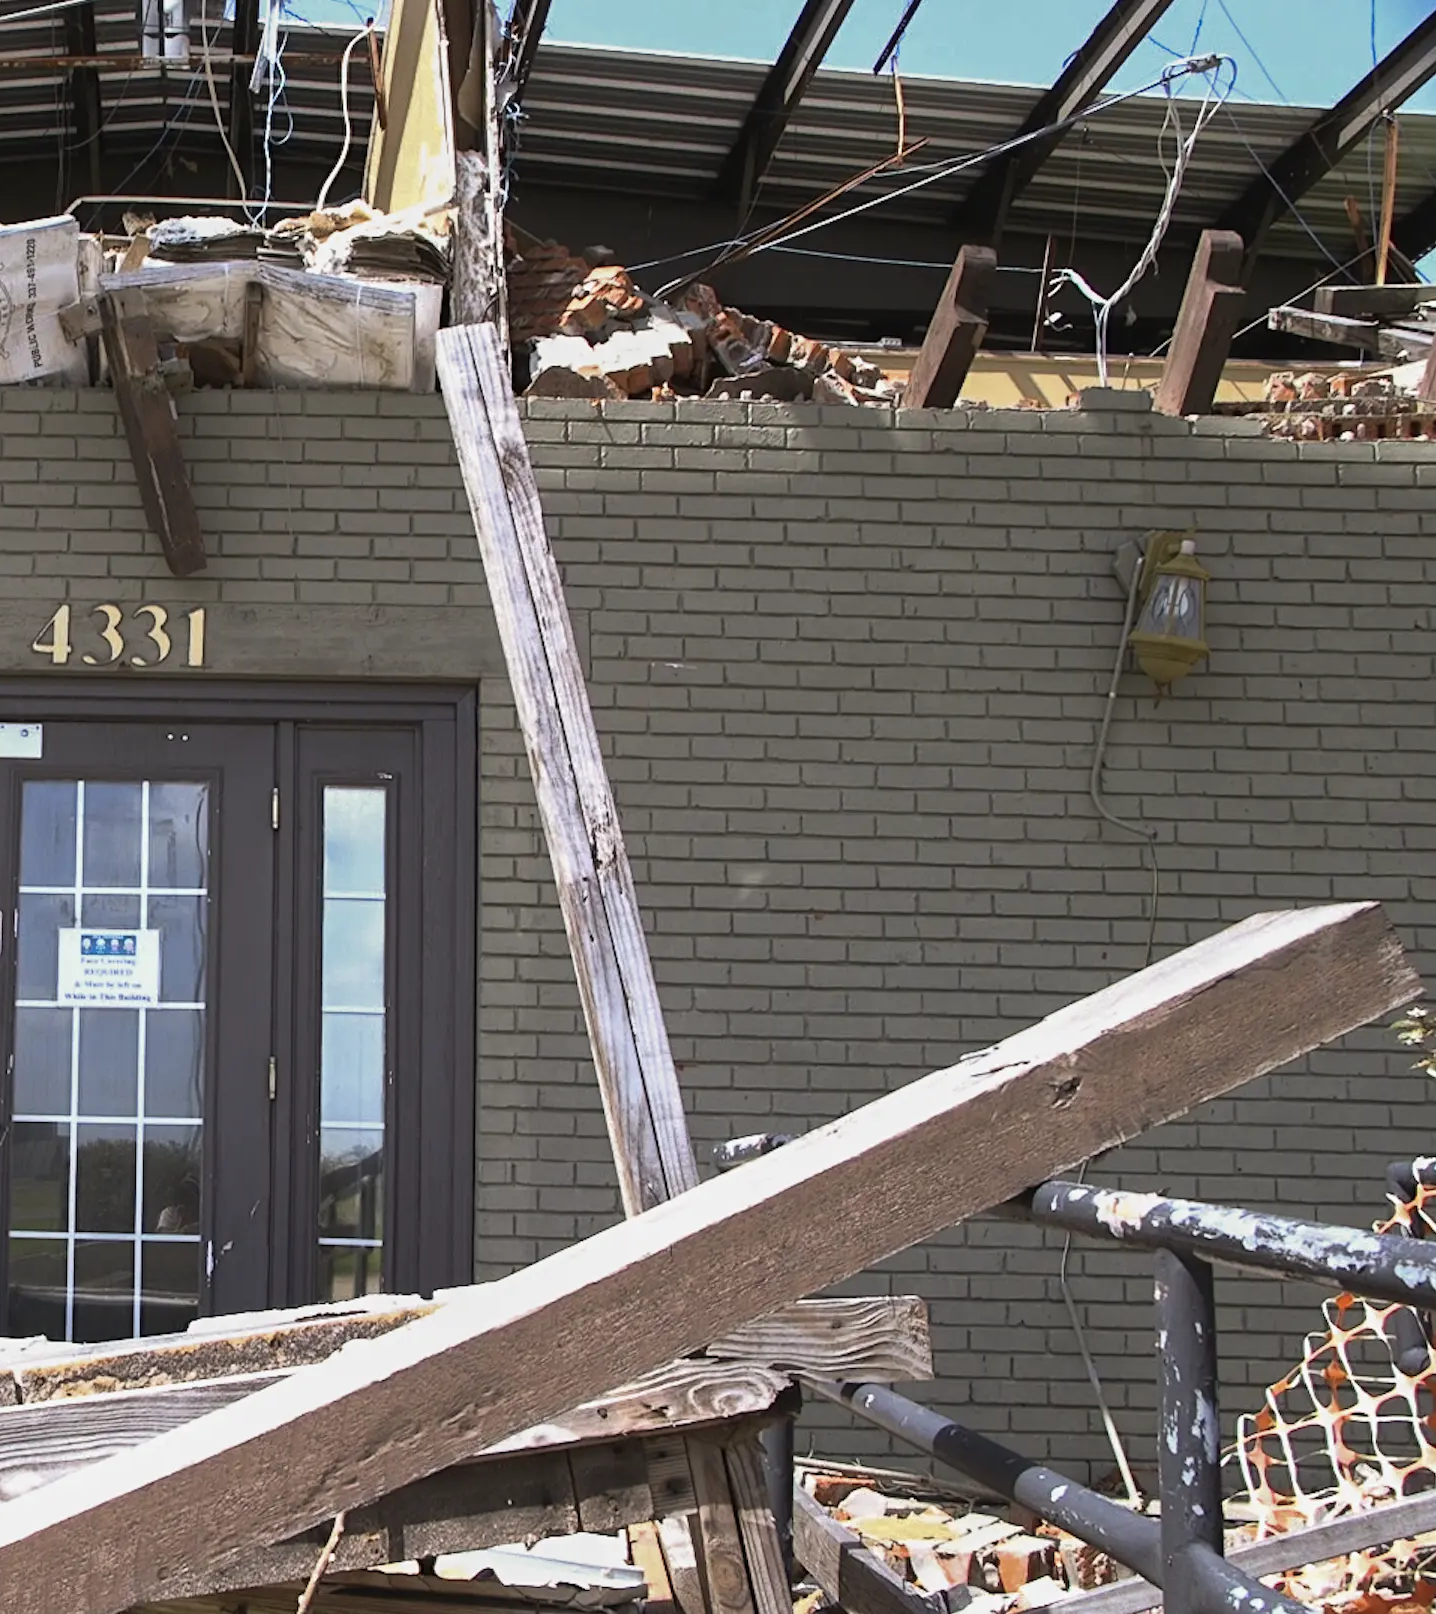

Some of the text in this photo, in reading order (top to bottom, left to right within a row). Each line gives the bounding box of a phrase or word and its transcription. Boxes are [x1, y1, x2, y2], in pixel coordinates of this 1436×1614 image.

[26, 238, 37, 299] 337-491-1220
[28, 334, 43, 368] PUBLIC
[32, 603, 206, 667] 4331
[84, 968, 133, 977] REQUIRED
[100, 957, 136, 967] Covering
[64, 992, 87, 1000] While
[99, 992, 117, 1000] This
[118, 993, 152, 1003] Building
